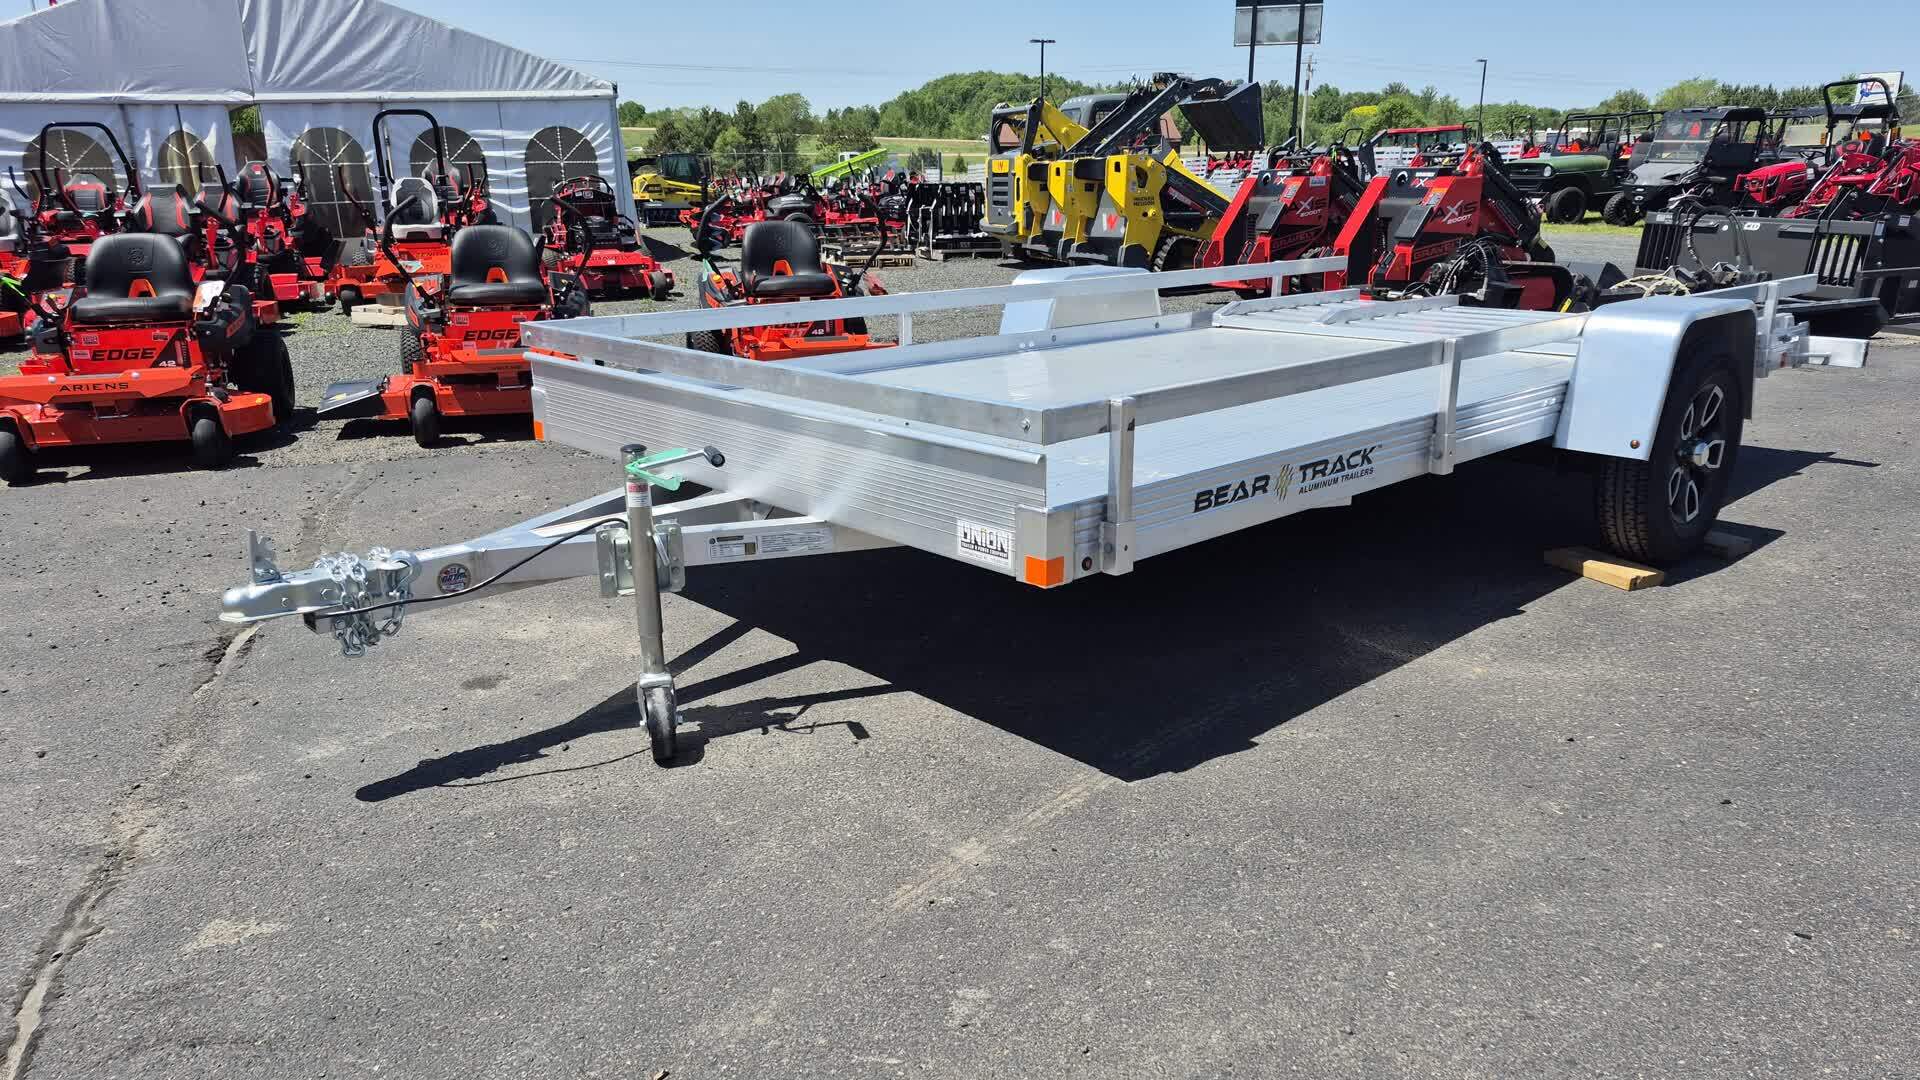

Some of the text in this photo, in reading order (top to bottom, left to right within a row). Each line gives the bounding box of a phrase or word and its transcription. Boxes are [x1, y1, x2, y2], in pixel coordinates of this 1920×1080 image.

[1429, 199, 1479, 223] AXIS
[1446, 213, 1473, 225] 2000T
[463, 329, 520, 341] EDGE
[91, 348, 156, 361] EDGE
[59, 382, 129, 392] ARIENS
[1193, 446, 1377, 513] BEAR TRACK
[1298, 467, 1375, 495] ALUMINUM TRAILERS
